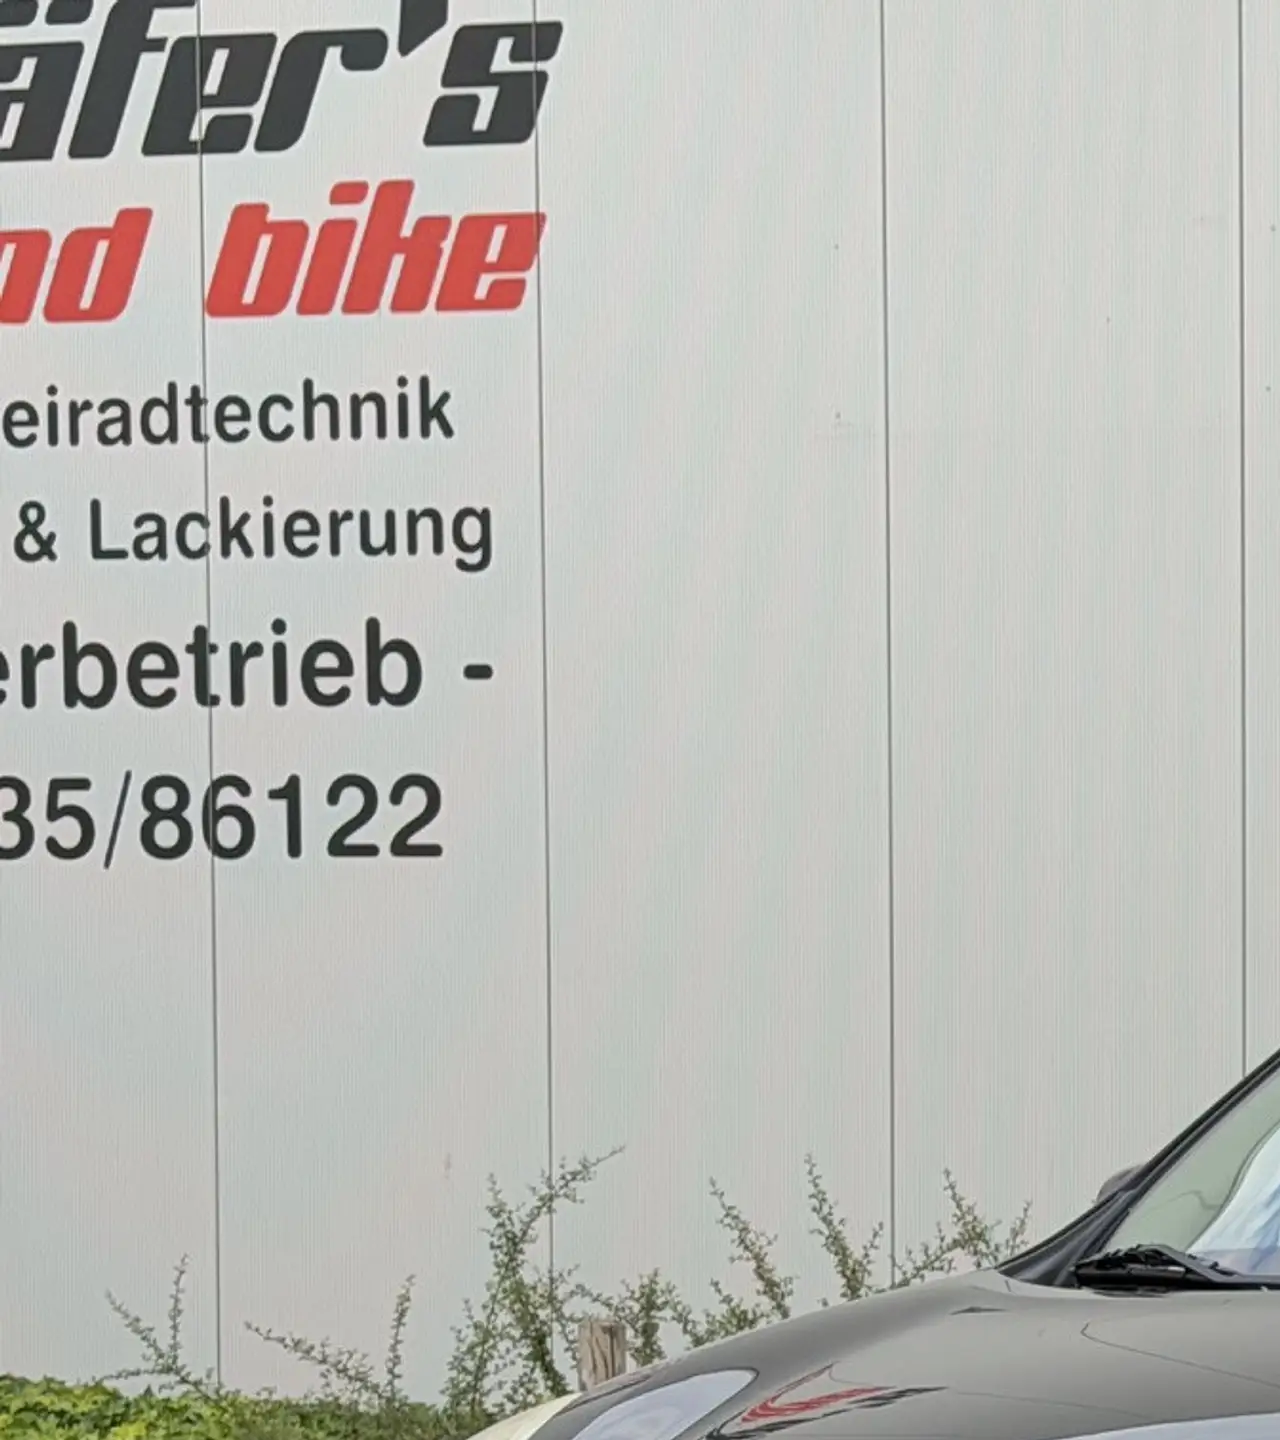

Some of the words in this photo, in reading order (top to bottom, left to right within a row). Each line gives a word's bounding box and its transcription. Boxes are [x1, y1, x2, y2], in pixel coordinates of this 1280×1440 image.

[206, 181, 545, 317] bike
[2, 376, 455, 447] eiradtechnik
[14, 501, 57, 562] &
[90, 497, 493, 573] Lackierung
[0, 618, 422, 709] rbetrieb
[0, 770, 443, 869] 35/86122
